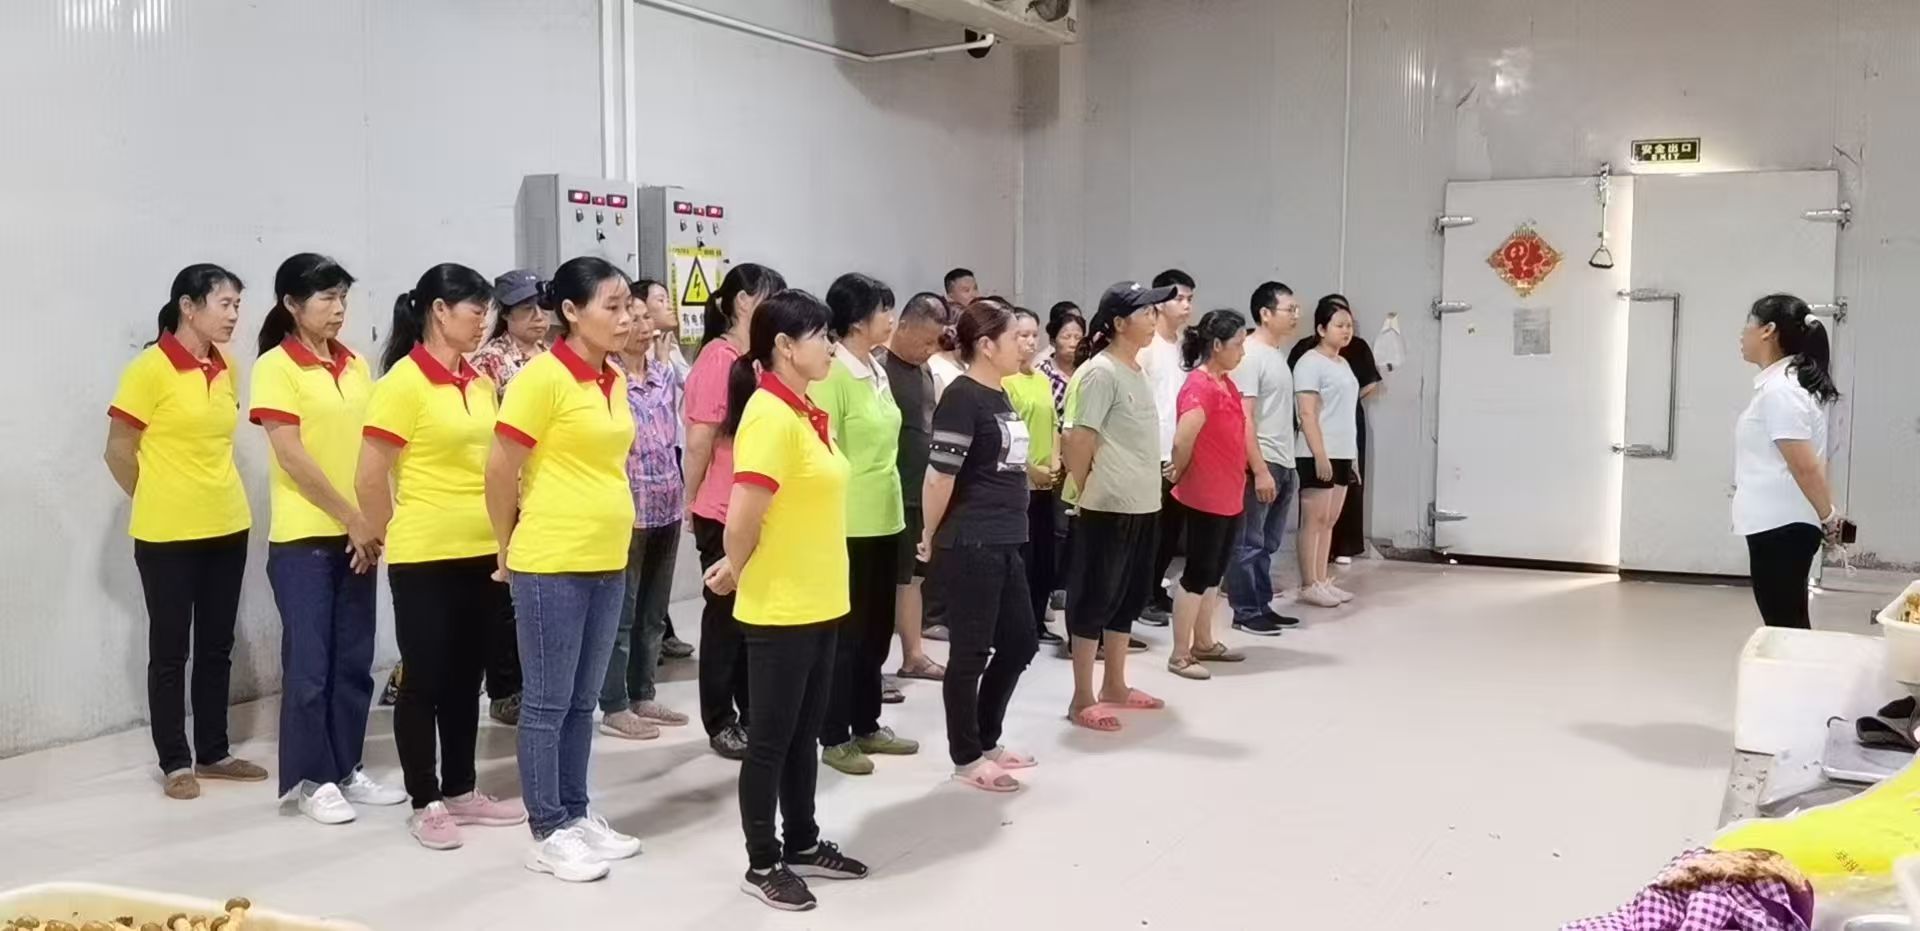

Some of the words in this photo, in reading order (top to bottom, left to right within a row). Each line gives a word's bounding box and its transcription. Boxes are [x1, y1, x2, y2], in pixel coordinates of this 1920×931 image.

[1641, 143, 1692, 154] 安全出口
[1651, 153, 1680, 161] EXIT
